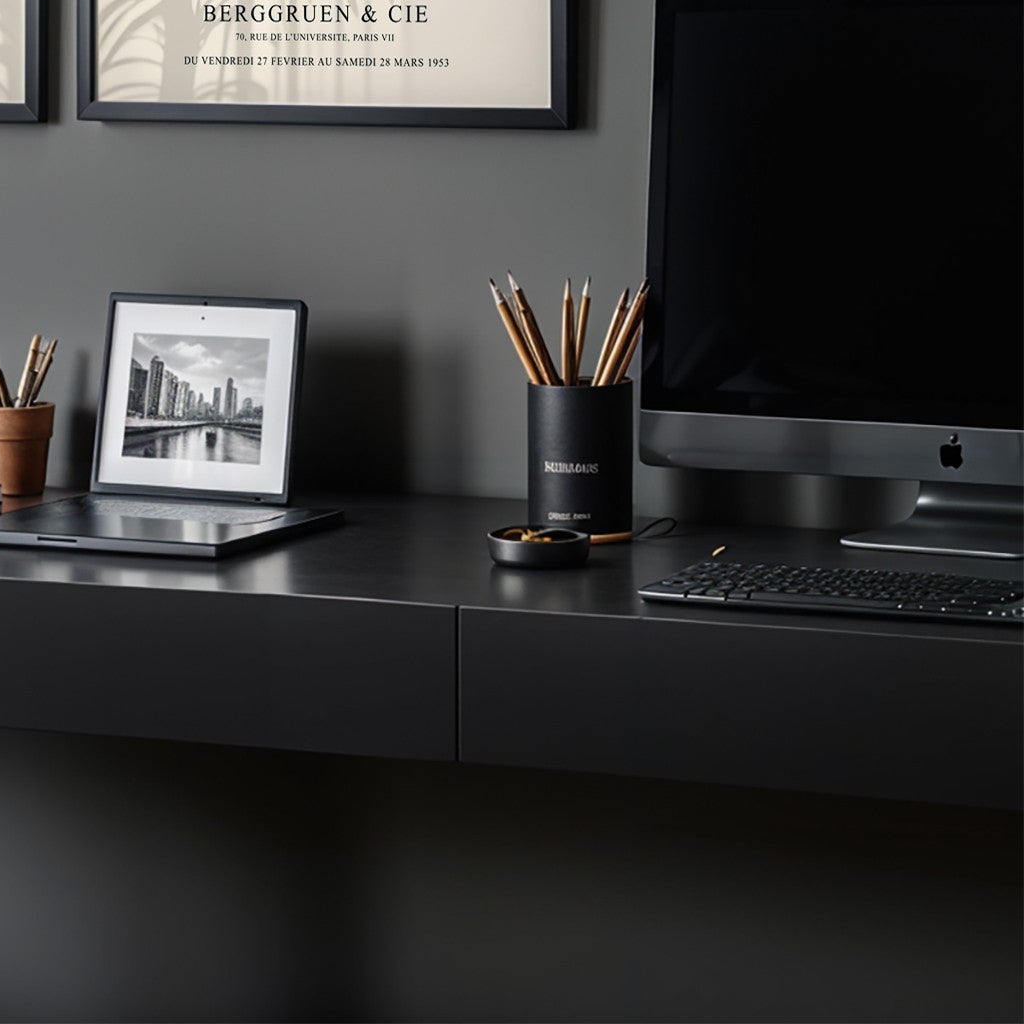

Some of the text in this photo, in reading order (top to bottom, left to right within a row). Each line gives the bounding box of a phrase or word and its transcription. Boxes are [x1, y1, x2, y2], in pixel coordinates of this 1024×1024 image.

[203, 4, 428, 23] BERGGRUEN & CIE
[235, 33, 247, 42] 70,
[250, 33, 267, 41] RUE
[270, 33, 283, 41] DE
[353, 33, 378, 42] PARIS
[381, 34, 395, 42] VII
[184, 56, 198, 65] DU
[202, 56, 253, 66] VENDREDI
[257, 56, 267, 66] 27
[318, 57, 332, 67] AU
[336, 57, 376, 67] SAMEDI
[379, 58, 391, 67] 28
[394, 58, 424, 67] MARS
[428, 58, 450, 68] 1953
